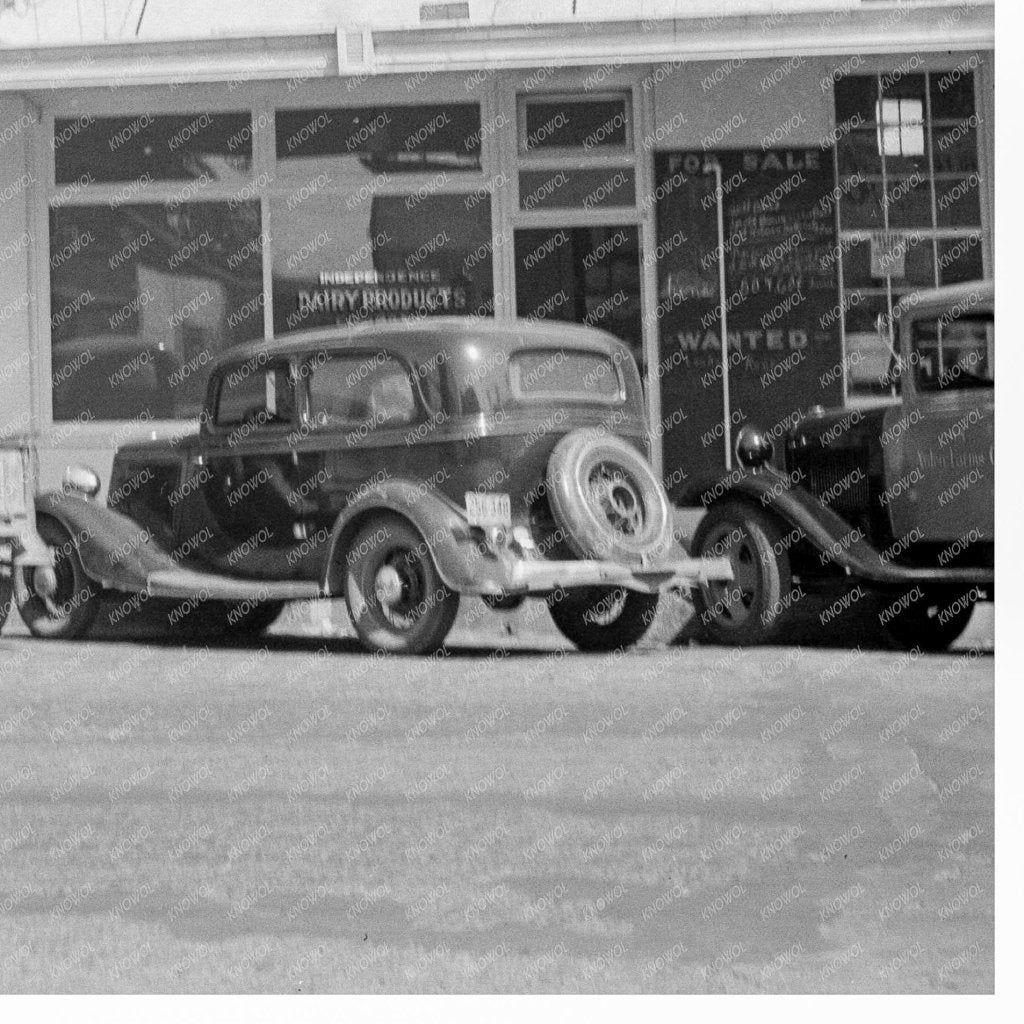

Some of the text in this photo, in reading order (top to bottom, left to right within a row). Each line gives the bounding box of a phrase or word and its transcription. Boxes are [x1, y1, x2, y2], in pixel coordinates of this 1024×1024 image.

[743, 151, 820, 172] SALE
[319, 269, 441, 286] INDEPENDENCE
[298, 286, 466, 312] DAIRY PRODUCTS
[677, 329, 809, 351] WANTED
